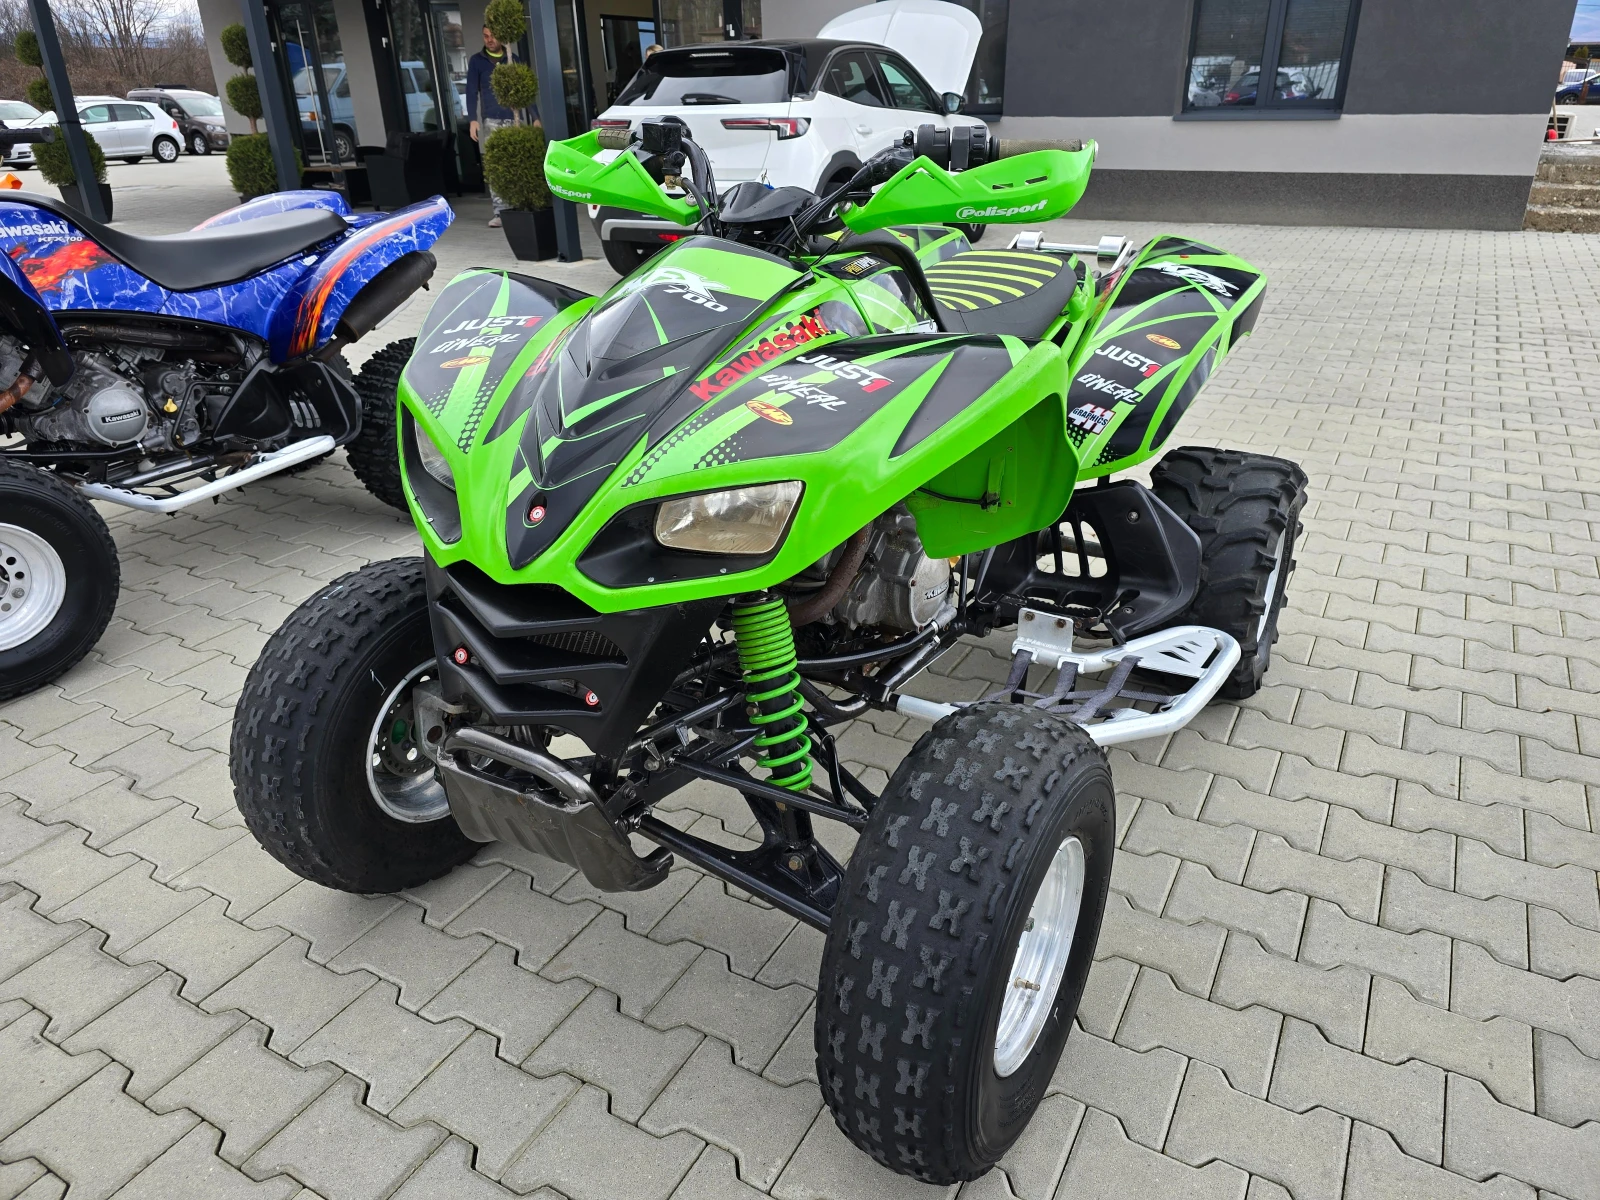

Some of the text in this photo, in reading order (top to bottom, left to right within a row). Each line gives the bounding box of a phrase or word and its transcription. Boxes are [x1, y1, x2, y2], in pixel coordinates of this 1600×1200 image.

[956, 199, 1049, 219] Polisport
[0, 220, 69, 238] awasaki
[663, 284, 729, 312] 700
[443, 315, 544, 334] JUST1
[689, 308, 831, 402] Kawasaki
[1095, 345, 1162, 379] JUST1
[796, 354, 894, 393] JUST1
[105, 410, 140, 423] Kawasaki
[1072, 408, 1109, 426] GRAPHICS
